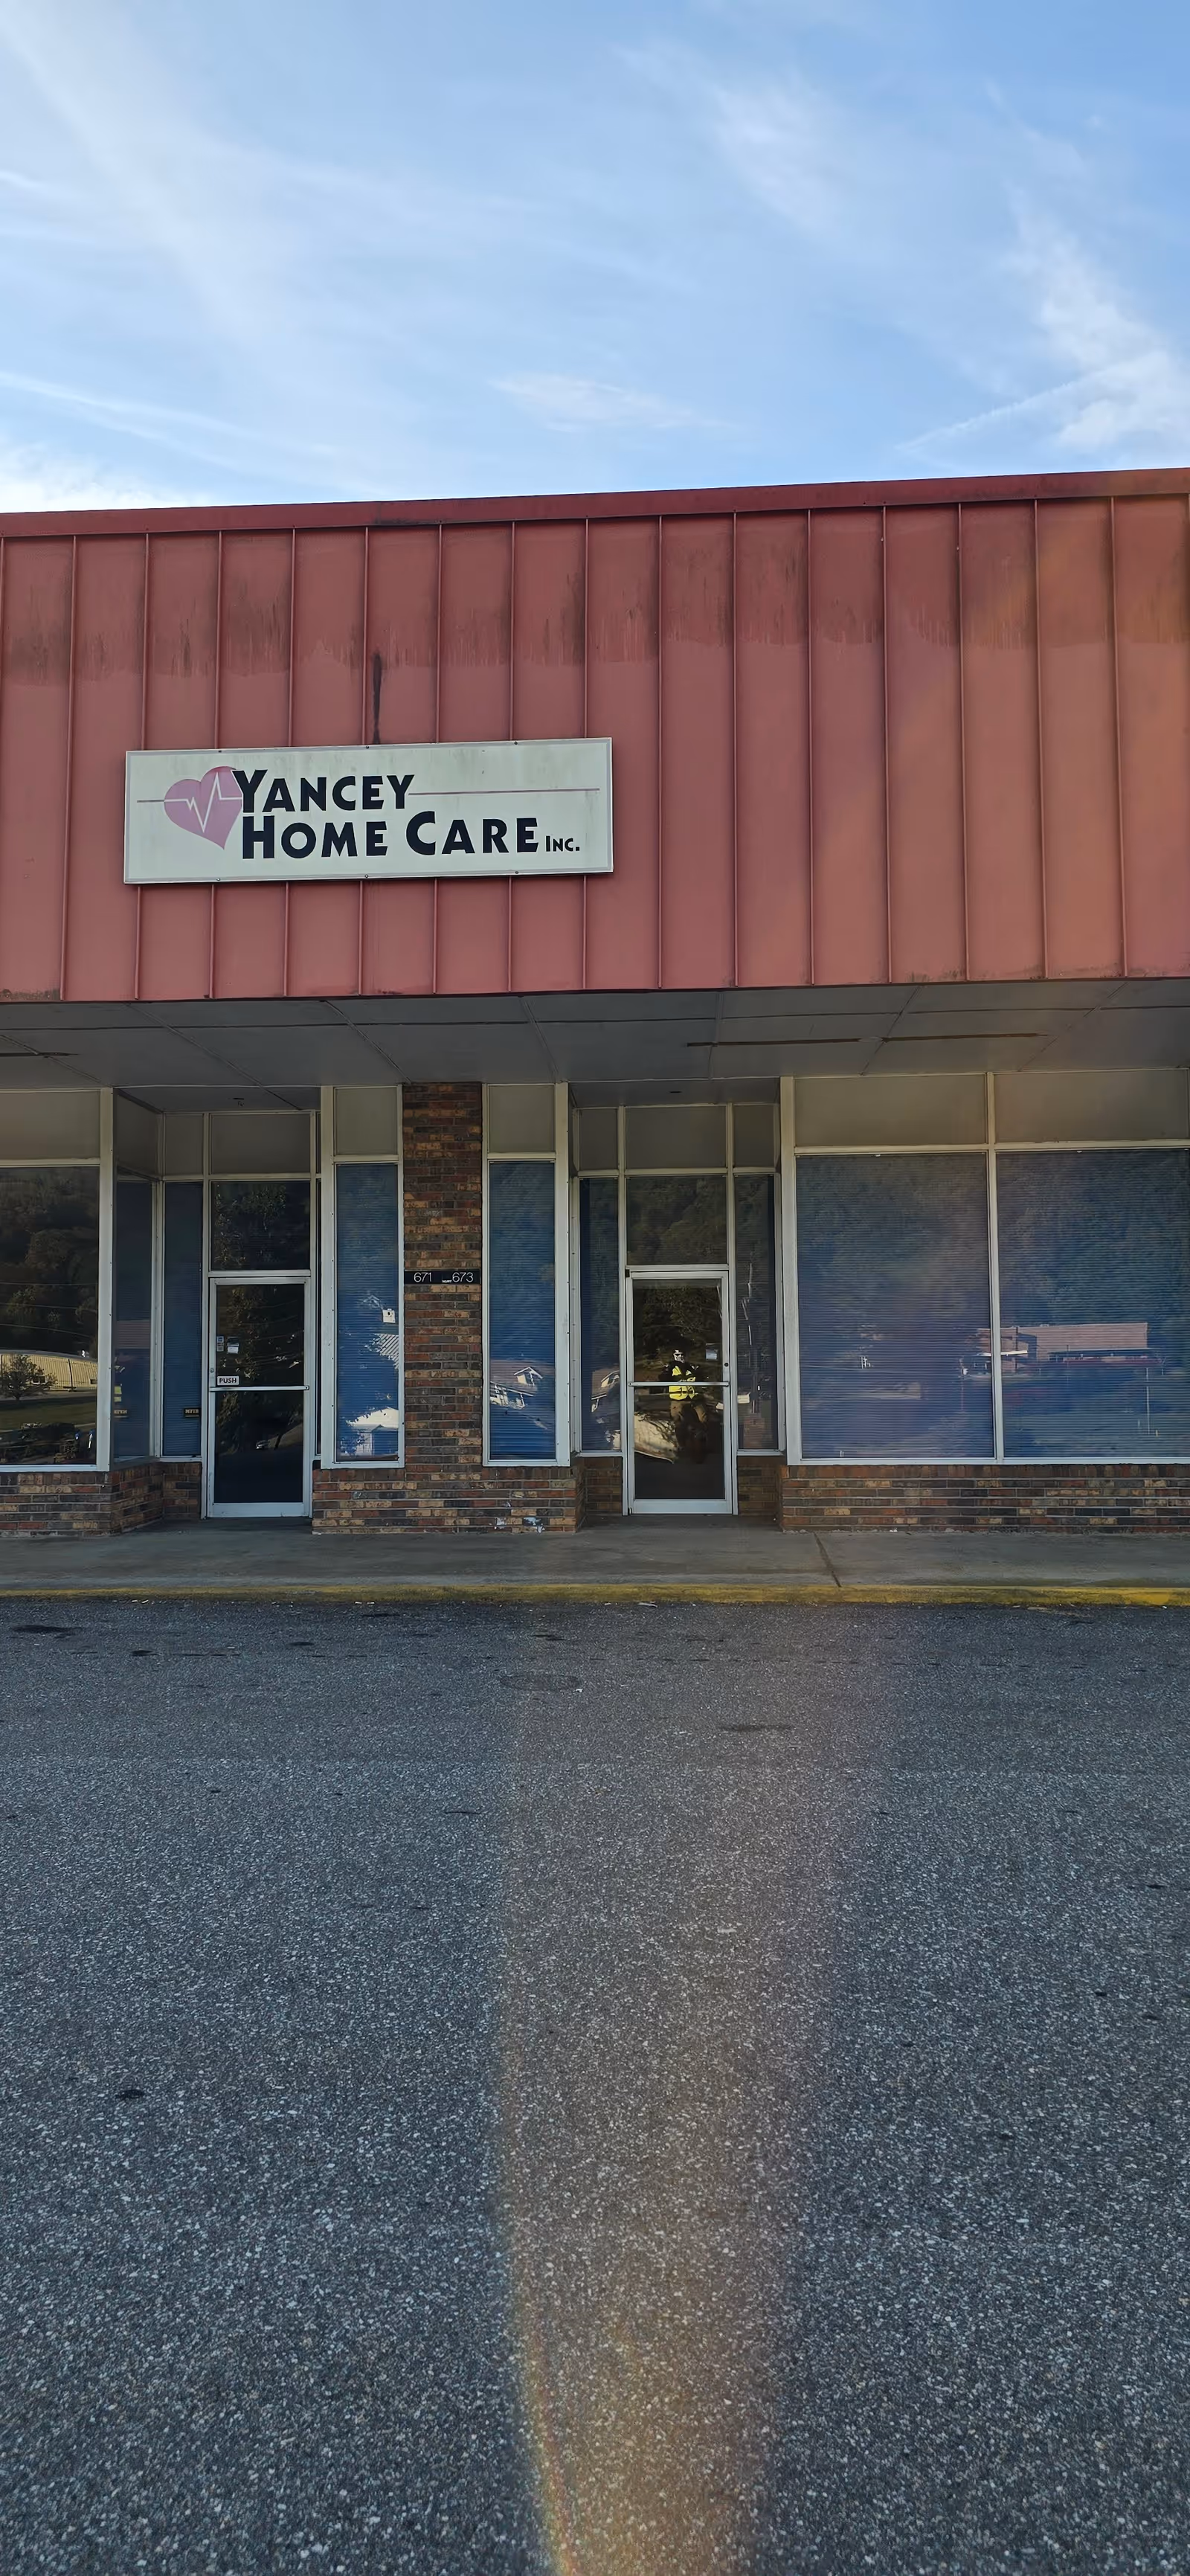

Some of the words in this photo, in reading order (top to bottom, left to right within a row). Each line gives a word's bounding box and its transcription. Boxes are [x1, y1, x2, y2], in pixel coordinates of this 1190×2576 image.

[231, 769, 415, 813] YANCEY
[242, 815, 388, 860] HOME
[405, 810, 539, 856] CARE
[545, 835, 581, 852] INC.
[414, 1272, 432, 1282] 671
[452, 1272, 474, 1282] 673
